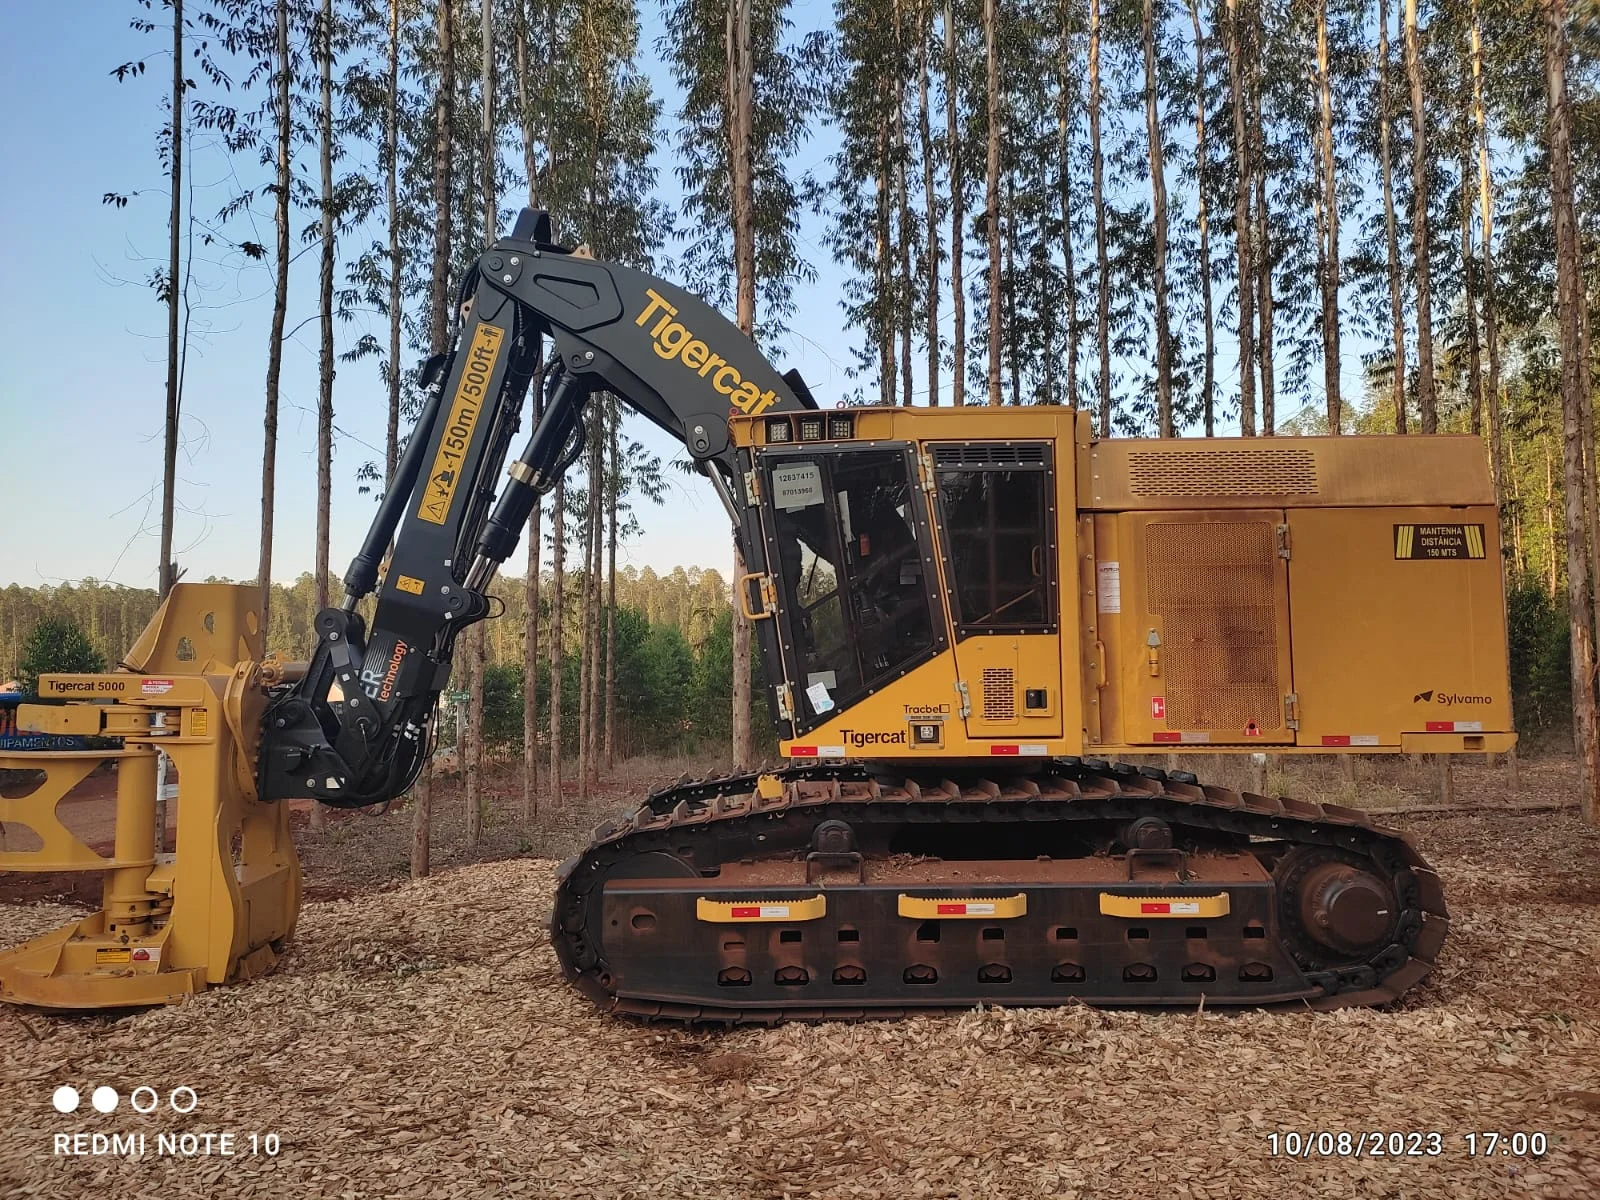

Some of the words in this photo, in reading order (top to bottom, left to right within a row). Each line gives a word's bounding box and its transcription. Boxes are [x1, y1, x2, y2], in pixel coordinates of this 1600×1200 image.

[634, 288, 777, 415] Tigercat
[442, 408, 475, 460] 150m
[463, 346, 494, 397] 500ft
[1420, 527, 1463, 535] MANTENHA
[1421, 536, 1462, 546] DISTÂNCIA
[1427, 548, 1440, 557] 150
[1441, 548, 1457, 557] MTS
[377, 639, 408, 702] technology
[48, 680, 95, 692] Tigercat
[98, 681, 125, 691] 5000
[1437, 693, 1492, 706] Sylvamo
[903, 704, 943, 714] Tracbel
[839, 730, 906, 748] Tigercat
